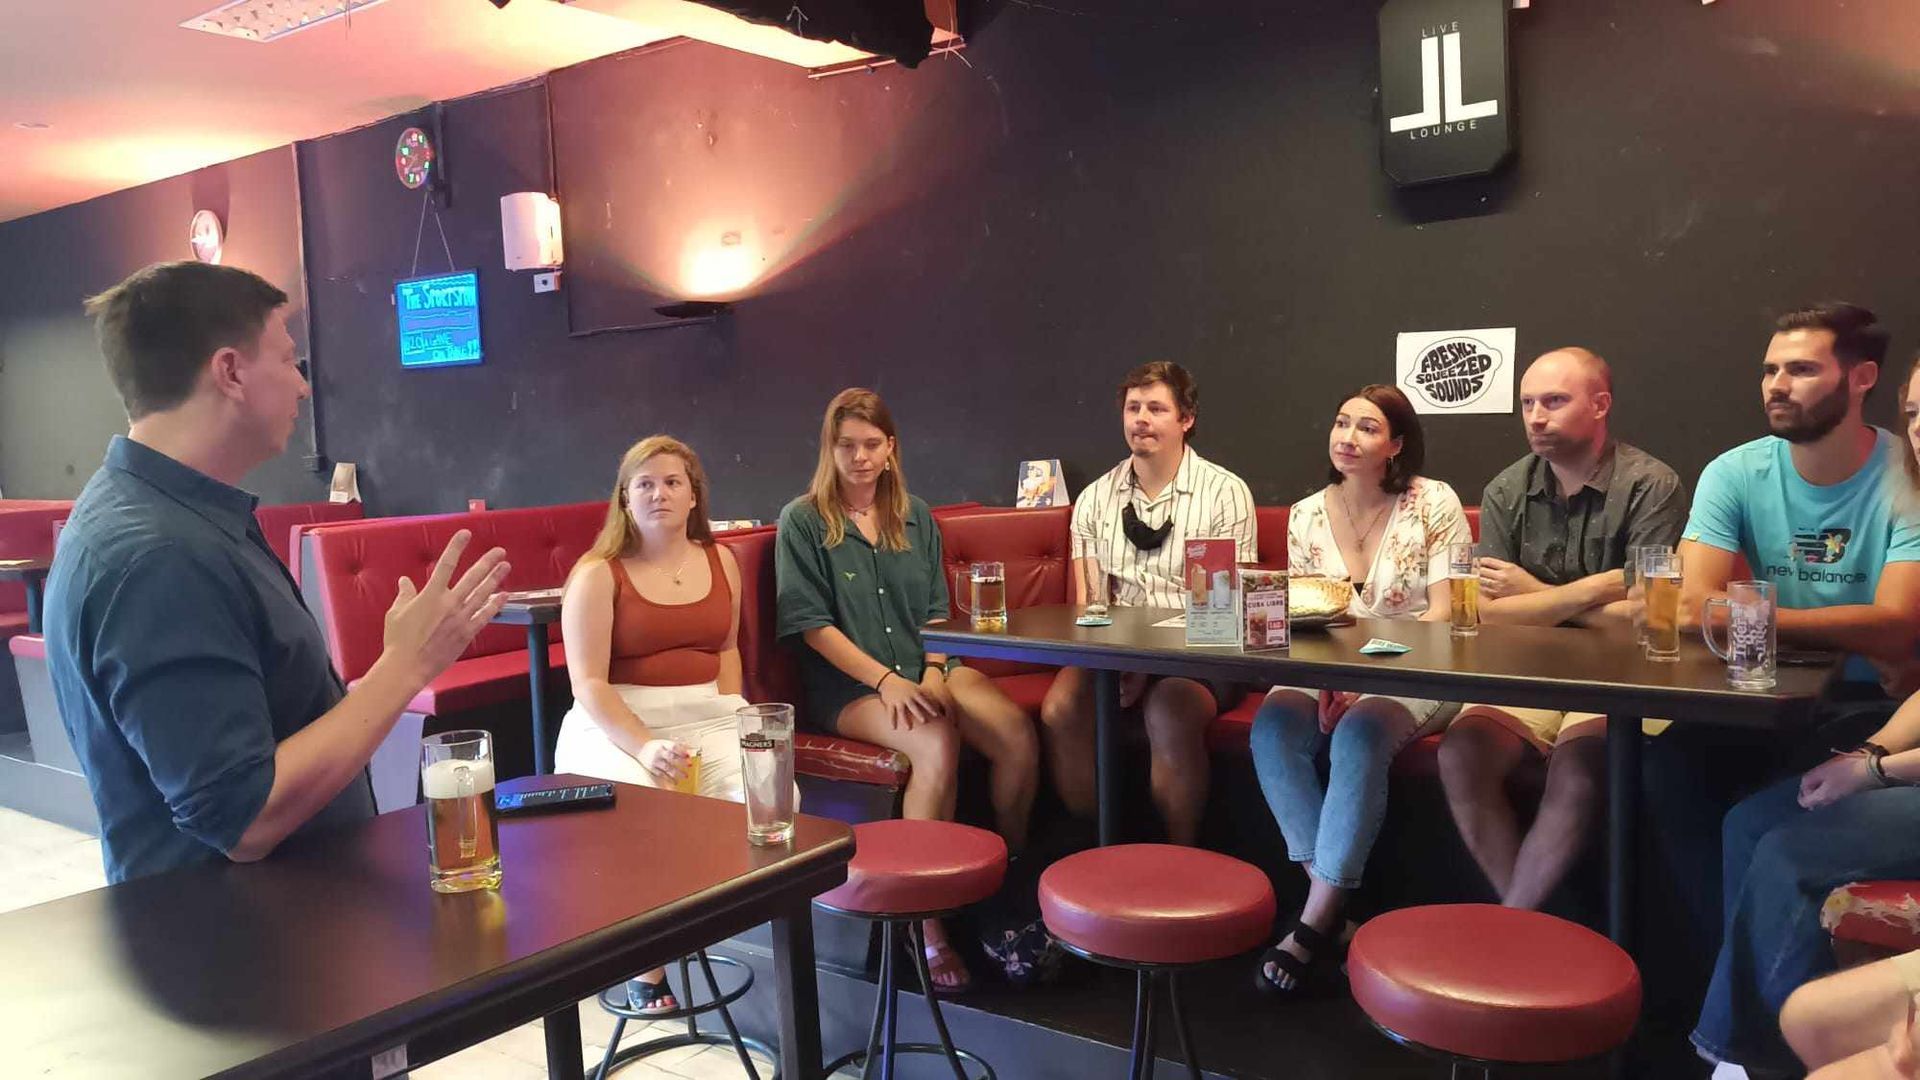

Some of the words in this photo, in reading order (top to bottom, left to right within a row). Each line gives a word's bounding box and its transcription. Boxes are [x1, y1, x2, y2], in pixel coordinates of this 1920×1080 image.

[1421, 21, 1460, 38] LIVE
[1410, 119, 1477, 140] LOUNGE
[1416, 354, 1492, 384] SQUEEZED
[1421, 342, 1477, 373] FRESHLY
[1425, 374, 1485, 402] SOUNDS
[1798, 569, 1868, 584] balance
[1732, 617, 1752, 662] Tiger
[741, 740, 773, 749] MAGNERS
